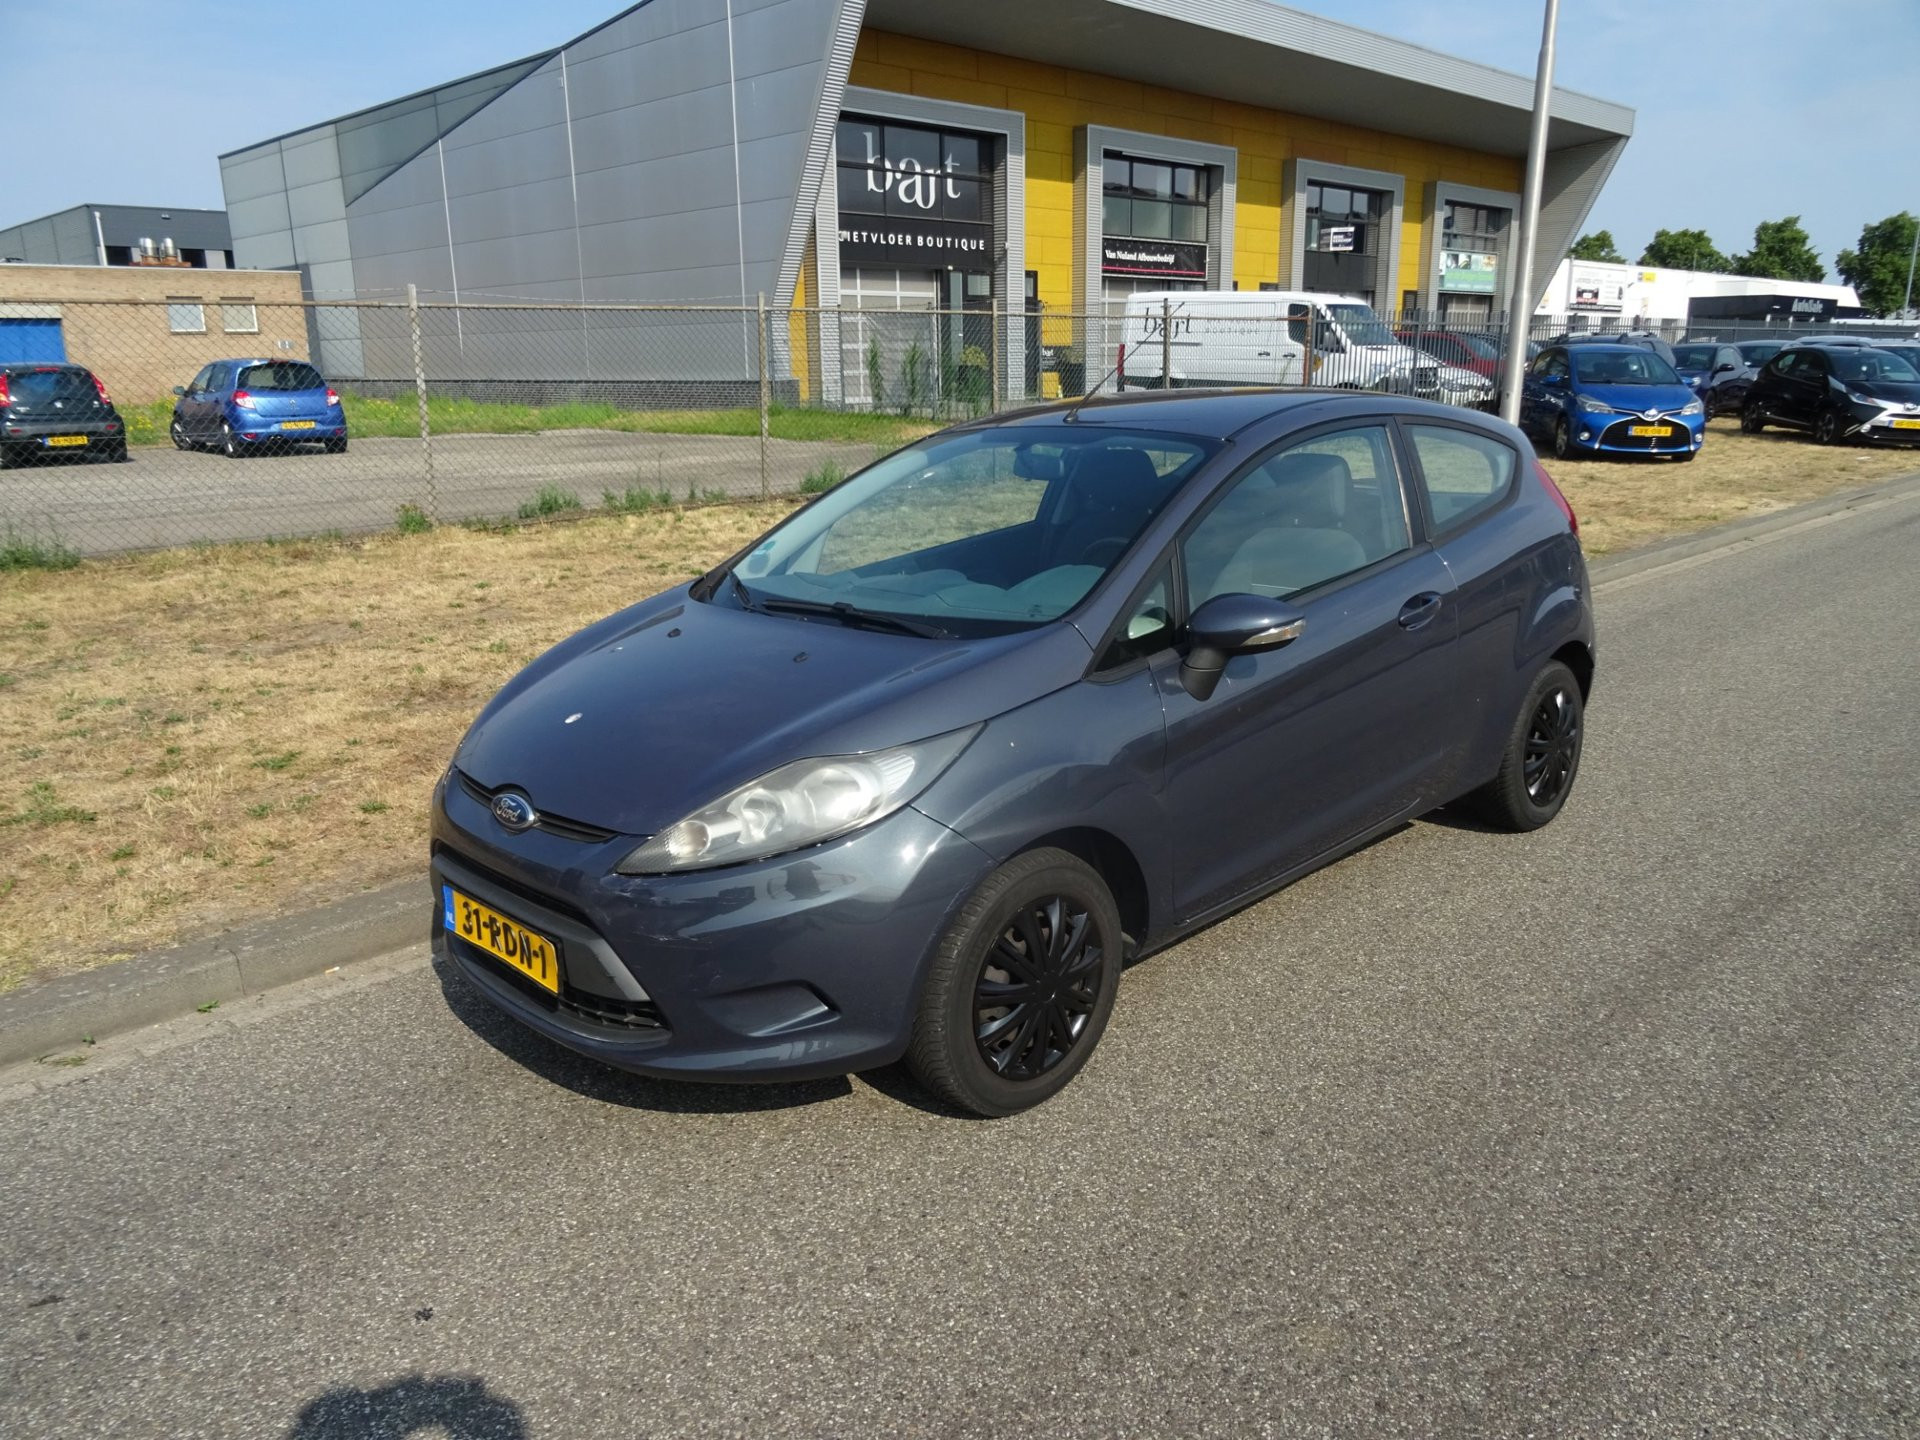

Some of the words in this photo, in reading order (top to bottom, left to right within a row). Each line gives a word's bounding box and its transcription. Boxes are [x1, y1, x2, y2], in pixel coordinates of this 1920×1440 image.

[863, 131, 961, 209] bart
[917, 235, 985, 251] BOUTIQUE
[1105, 249, 1116, 259] Van
[496, 797, 521, 822] Ford
[462, 900, 547, 980] 31-RDN-1
